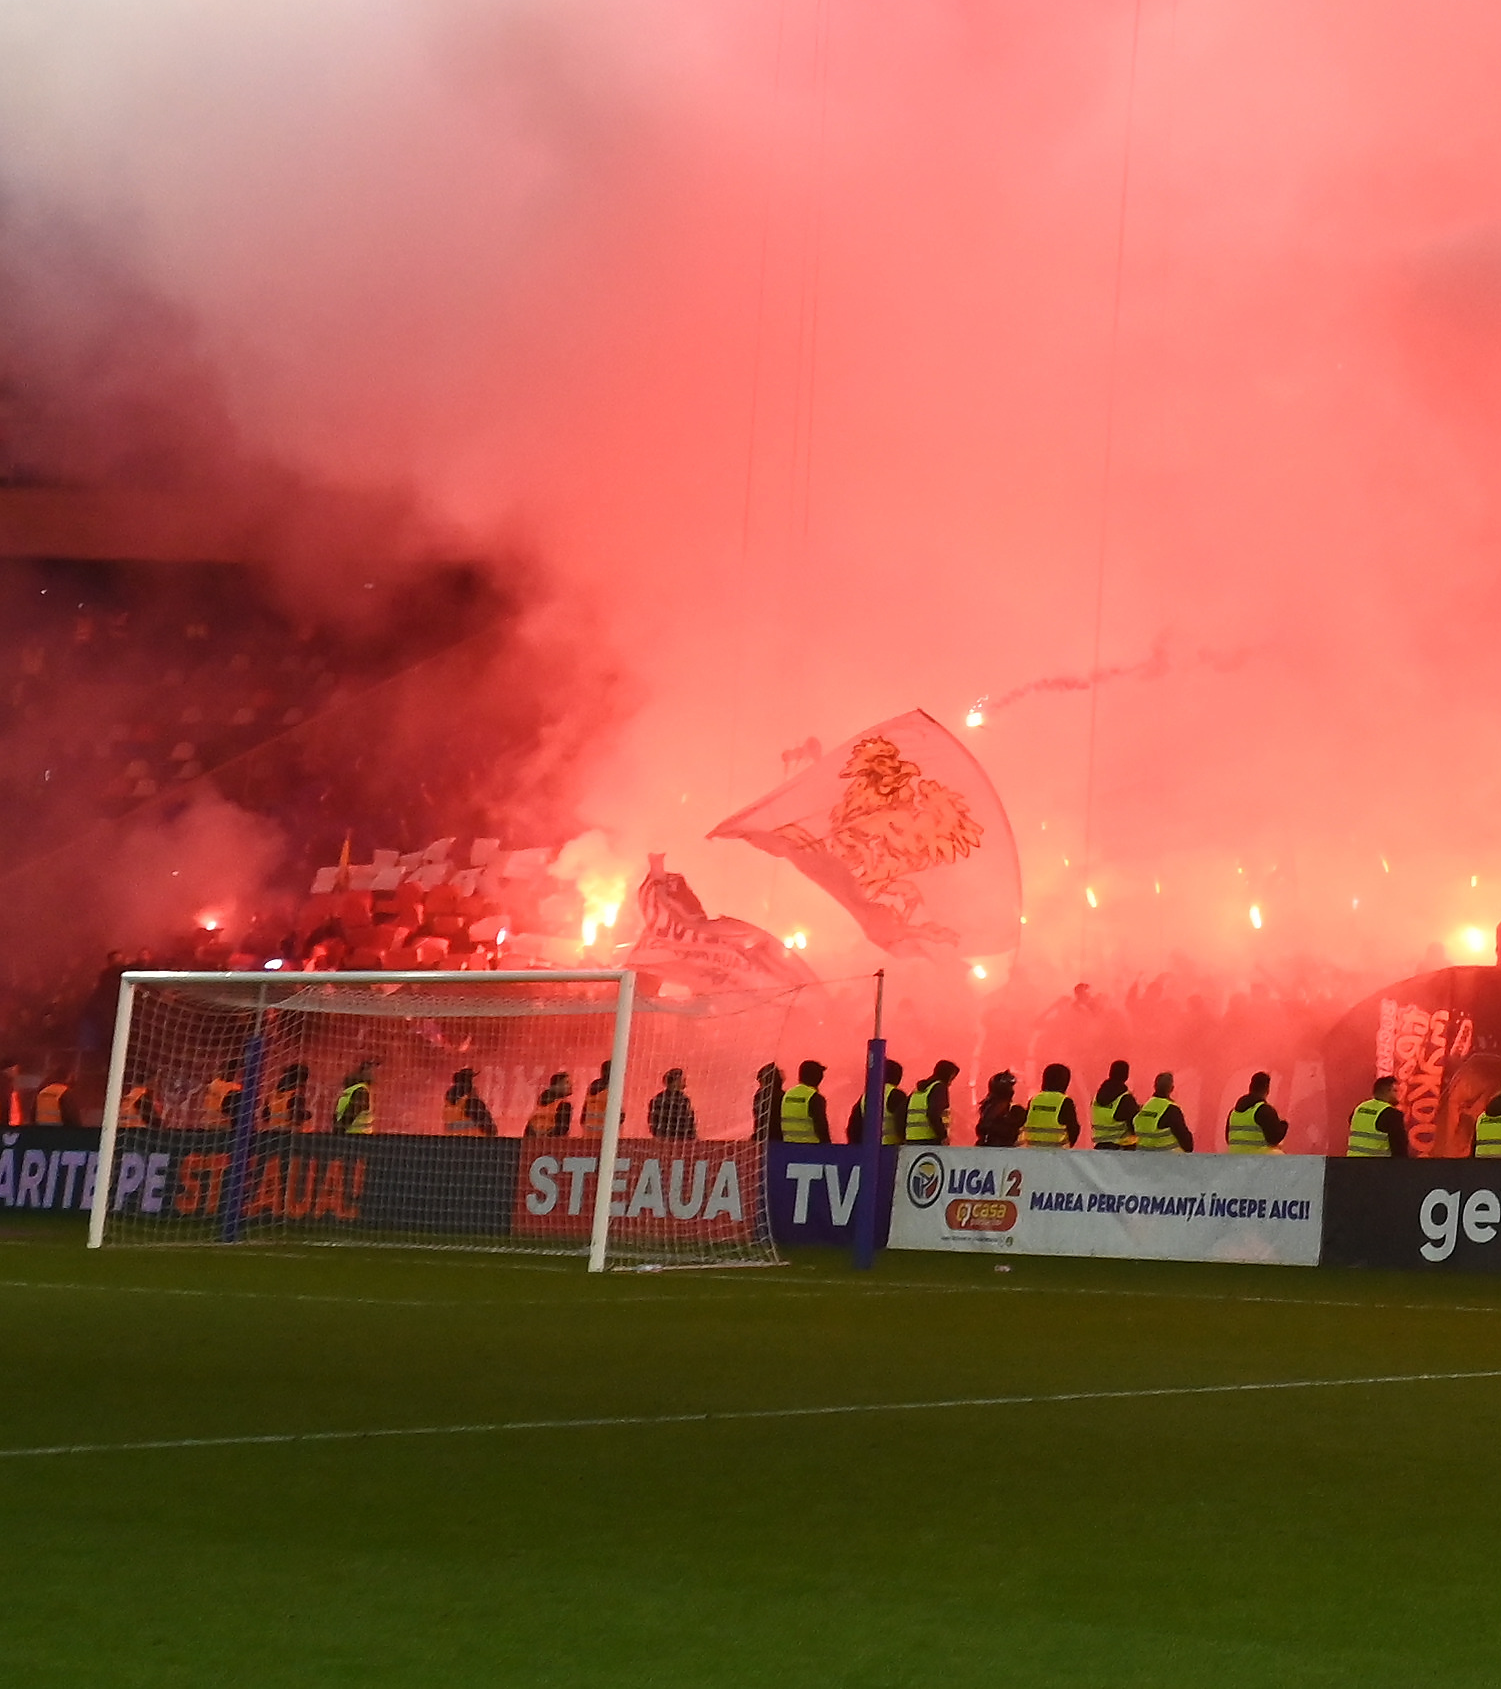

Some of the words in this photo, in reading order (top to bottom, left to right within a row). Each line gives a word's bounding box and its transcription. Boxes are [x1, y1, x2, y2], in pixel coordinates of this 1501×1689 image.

[174, 1152, 366, 1220] STAUA!
[526, 1156, 744, 1221] STEAUA
[786, 1163, 861, 1226] TV
[948, 1169, 996, 1196] LIGA
[1006, 1169, 1022, 1196] 2
[1030, 1191, 1084, 1213] MAREA
[1208, 1196, 1267, 1218] ÎNCEPE
